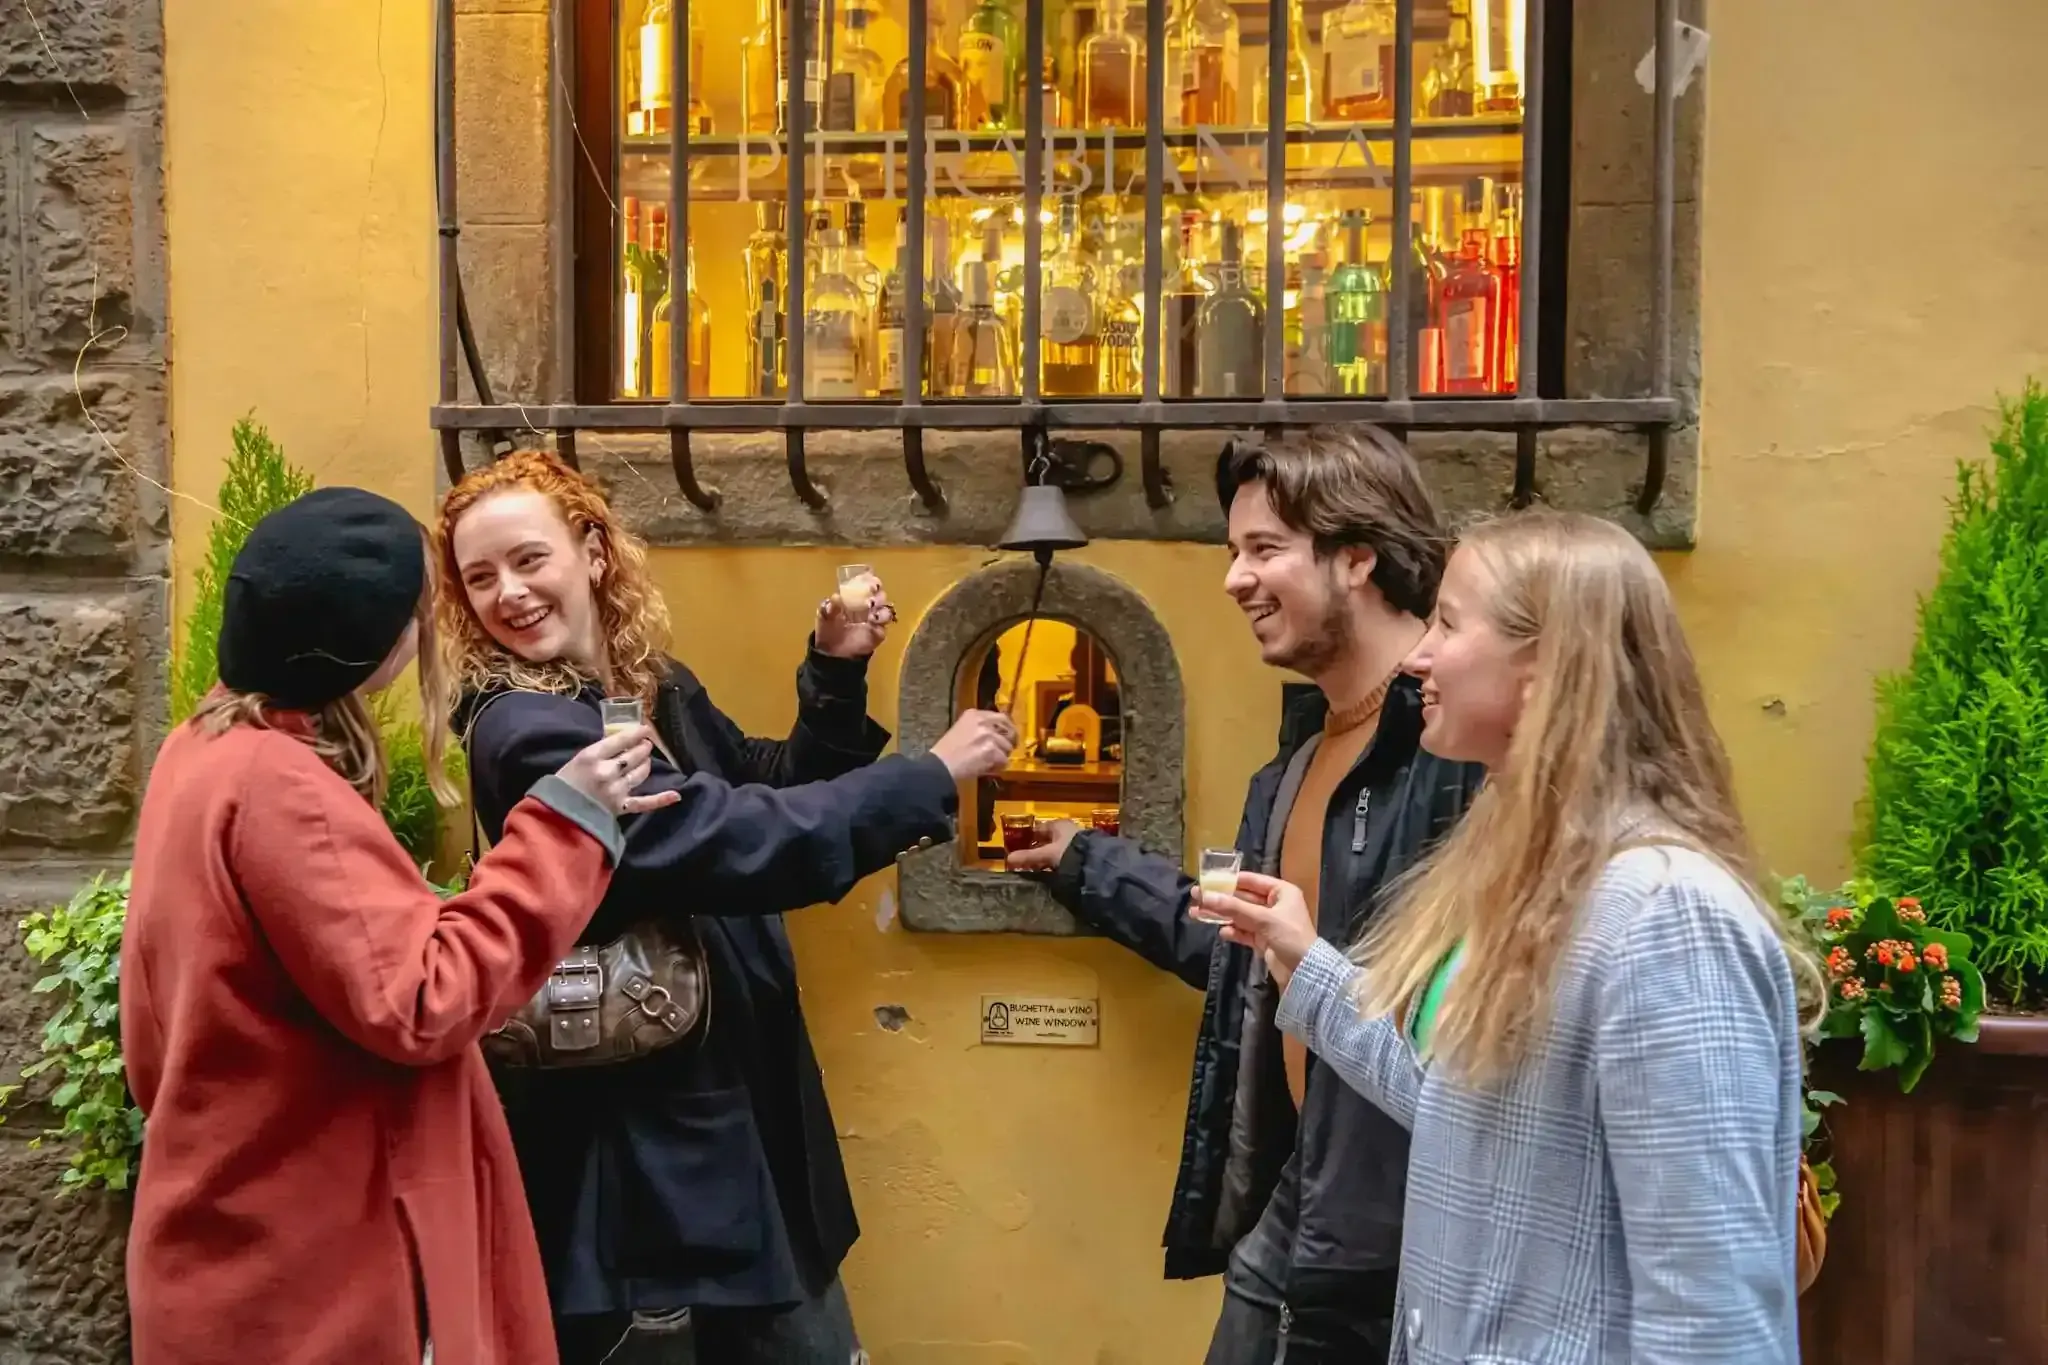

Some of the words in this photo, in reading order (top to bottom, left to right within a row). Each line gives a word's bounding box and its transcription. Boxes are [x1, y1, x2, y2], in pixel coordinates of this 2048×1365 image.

[737, 121, 1393, 202] PETRABIANCA
[1009, 1003, 1055, 1013] BUCHETTA
[1069, 1005, 1093, 1015] VINO
[1015, 1017, 1040, 1026] WINE
[1043, 1018, 1089, 1027] WINDOW
